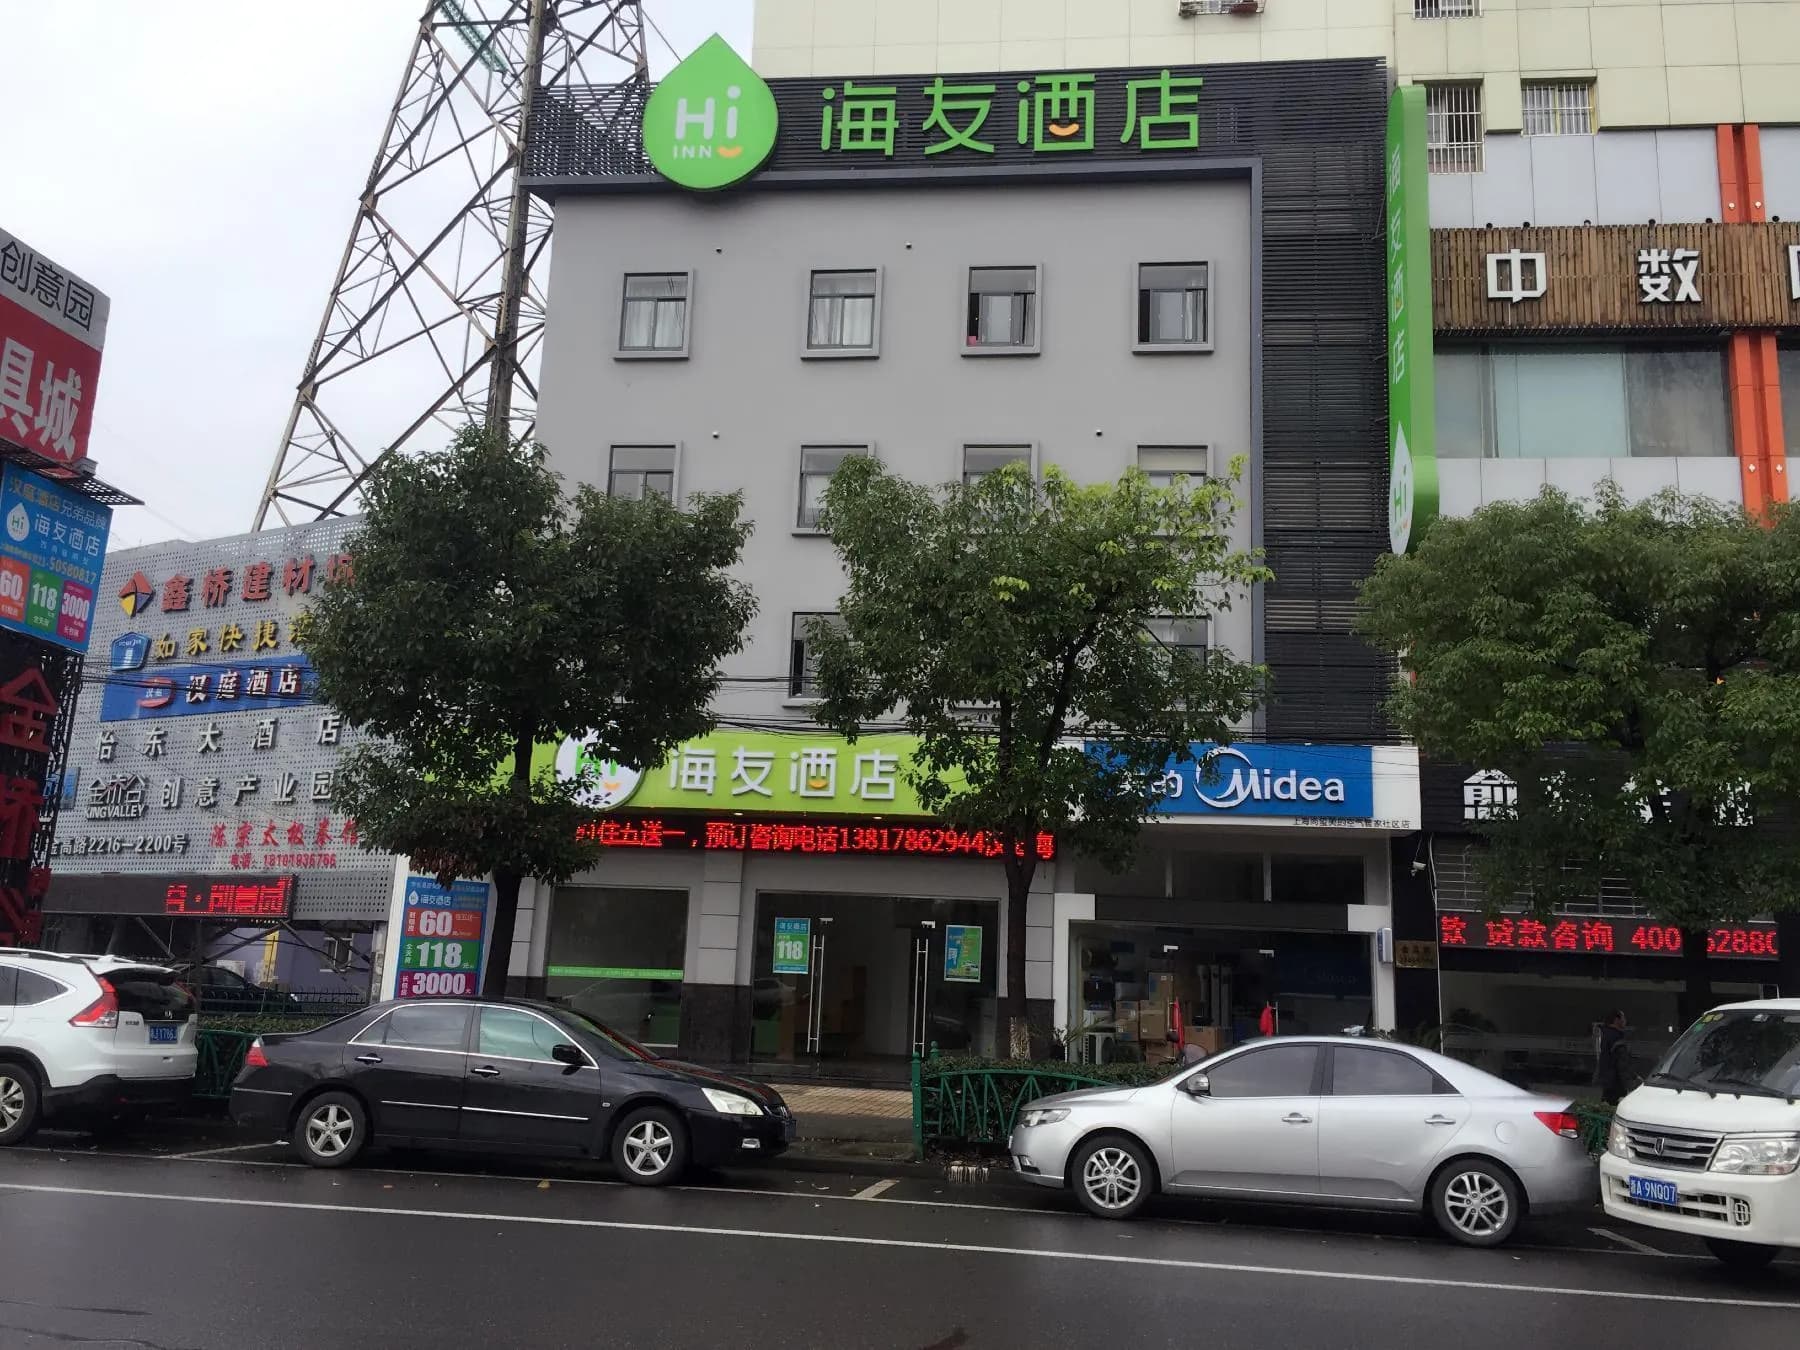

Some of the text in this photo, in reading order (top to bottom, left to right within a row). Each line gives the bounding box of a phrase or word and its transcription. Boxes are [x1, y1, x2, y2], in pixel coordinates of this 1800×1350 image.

[675, 85, 742, 140] Hi
[821, 70, 1203, 156] 海友酒店
[673, 145, 712, 159] INN
[1388, 144, 1405, 385] 海友酒店
[0, 240, 95, 331] 创意园
[0, 336, 82, 460] 具城
[34, 513, 101, 557] 海友酒店
[0, 570, 23, 602] 60
[32, 583, 58, 611] 118
[61, 592, 91, 622] 3000
[185, 664, 301, 704] 汉庭酒店
[98, 713, 343, 761] 怡东大酒店
[160, 769, 335, 809] 创意产业园
[668, 745, 899, 801] 海友酒店
[1215, 768, 1345, 803] Midea
[85, 804, 146, 819] KINGVALLEY
[419, 910, 453, 937] 60
[416, 941, 463, 969] 118
[776, 940, 803, 960] 118
[412, 972, 466, 995] 3000
